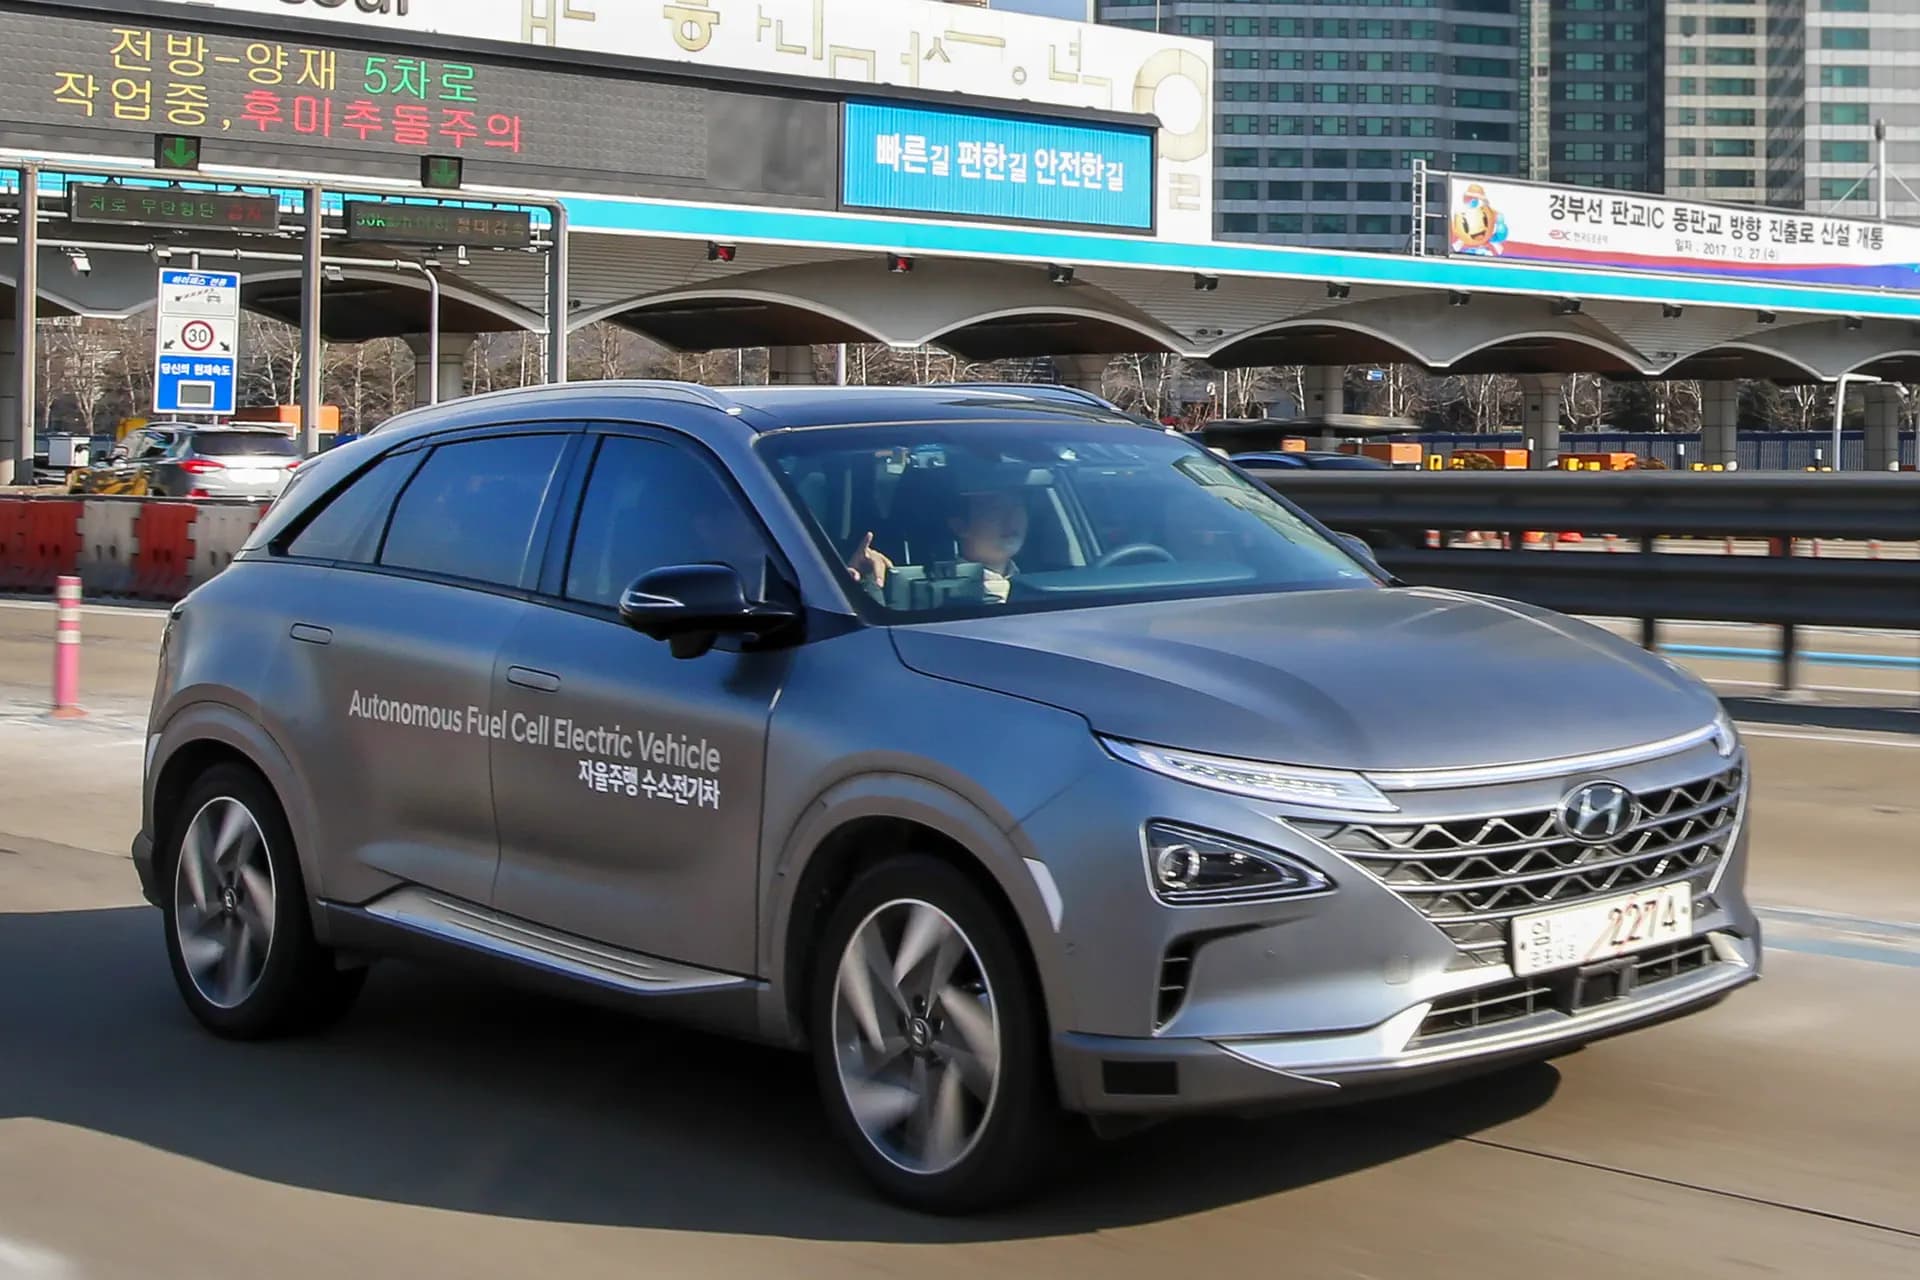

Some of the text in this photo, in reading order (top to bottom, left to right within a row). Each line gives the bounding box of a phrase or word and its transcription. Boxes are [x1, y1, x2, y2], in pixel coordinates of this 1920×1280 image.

[110, 28, 477, 101] 전방-양재 5차로
[875, 133, 1124, 192] 빠른길 편한길 안전한길
[1549, 194, 1884, 251] 경부선 판교IC 동판교 방향 진출로 신설 개통
[188, 328, 208, 343] 30
[349, 690, 720, 773] Autonomous Fuel Cell Electric Vehicle
[578, 759, 720, 809] 자율주행 수소전기차
[1607, 895, 1677, 946] 2274
